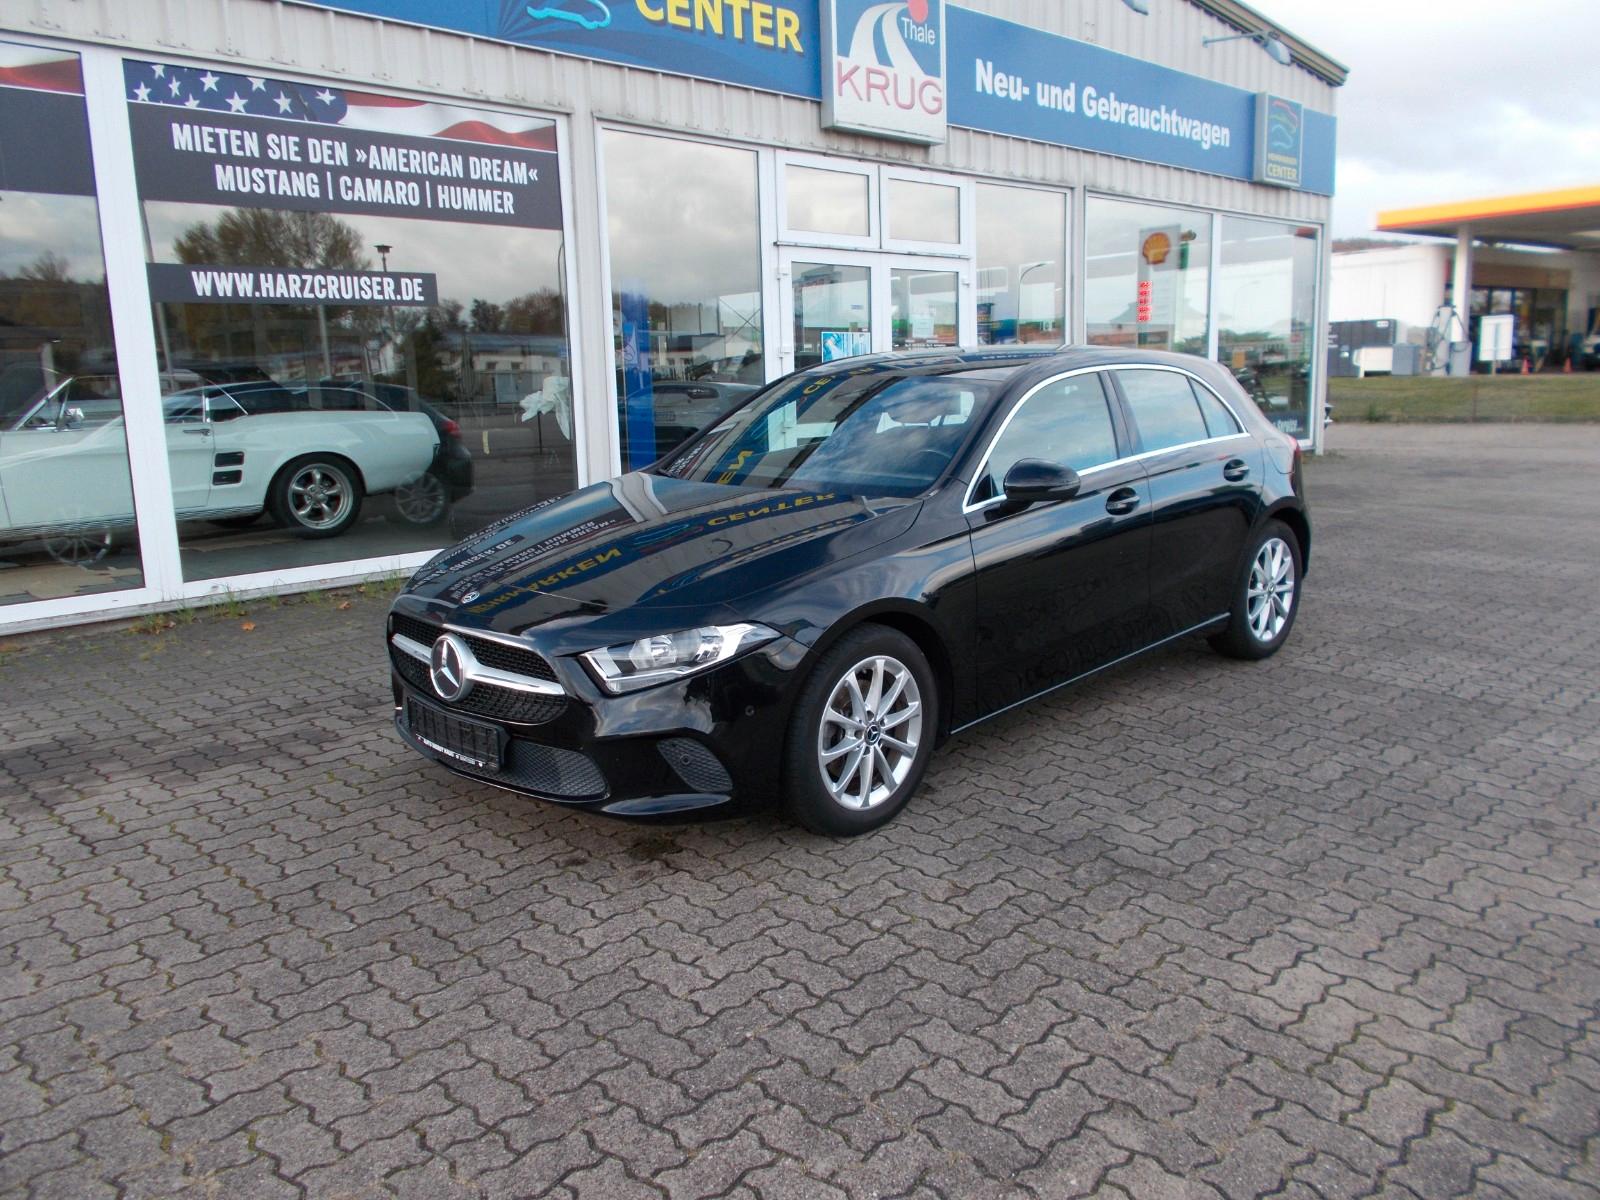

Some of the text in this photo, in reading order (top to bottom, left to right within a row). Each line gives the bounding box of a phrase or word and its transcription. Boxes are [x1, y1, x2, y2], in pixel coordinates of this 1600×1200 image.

[901, 17, 935, 45] Thale
[837, 61, 942, 115] KRUG
[975, 58, 1230, 150] Neu- und Gebrauchtwagen
[172, 123, 260, 158] MIETEN
[267, 133, 302, 162] SIE
[307, 138, 349, 167] DEN
[215, 164, 320, 198] MUSTANG
[340, 176, 420, 207] CAMARO
[437, 185, 515, 214] HUMMER
[191, 271, 424, 301] WWW.HARZCRUISER.DE
